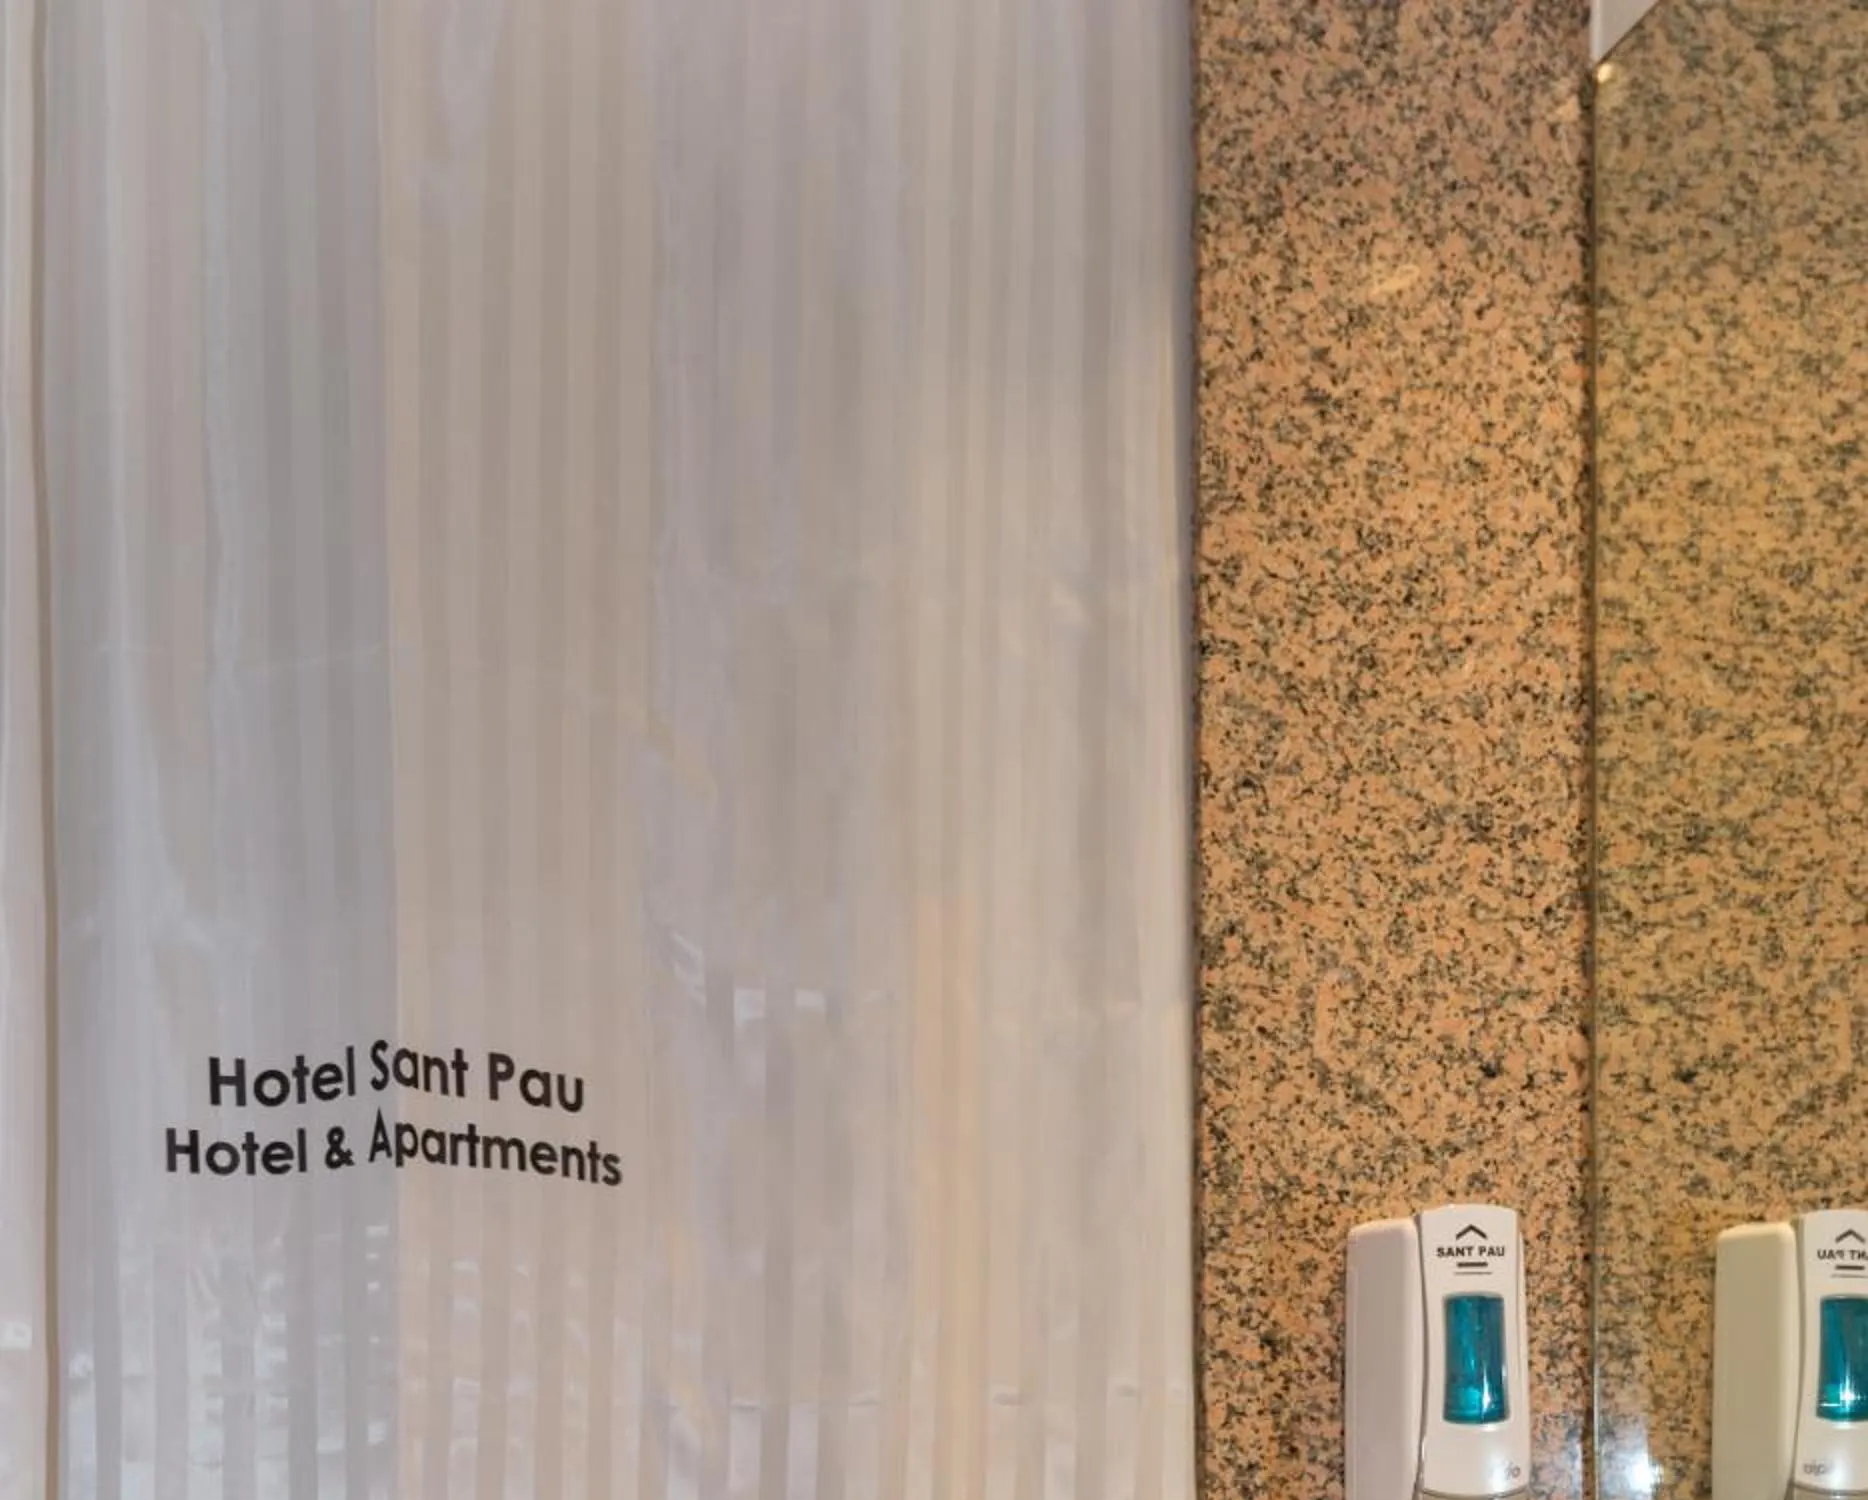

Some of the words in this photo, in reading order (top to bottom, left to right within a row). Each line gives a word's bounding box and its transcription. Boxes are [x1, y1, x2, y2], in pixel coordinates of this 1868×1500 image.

[208, 1044, 357, 1108] Hotel
[369, 1038, 470, 1099] Sant
[487, 1051, 585, 1114] Pau
[165, 1125, 308, 1177] Hotel
[323, 1125, 356, 1171] &
[367, 1107, 624, 1187] Apartments
[1436, 1245, 1475, 1259] SANT
[1477, 1244, 1505, 1258] PAU
